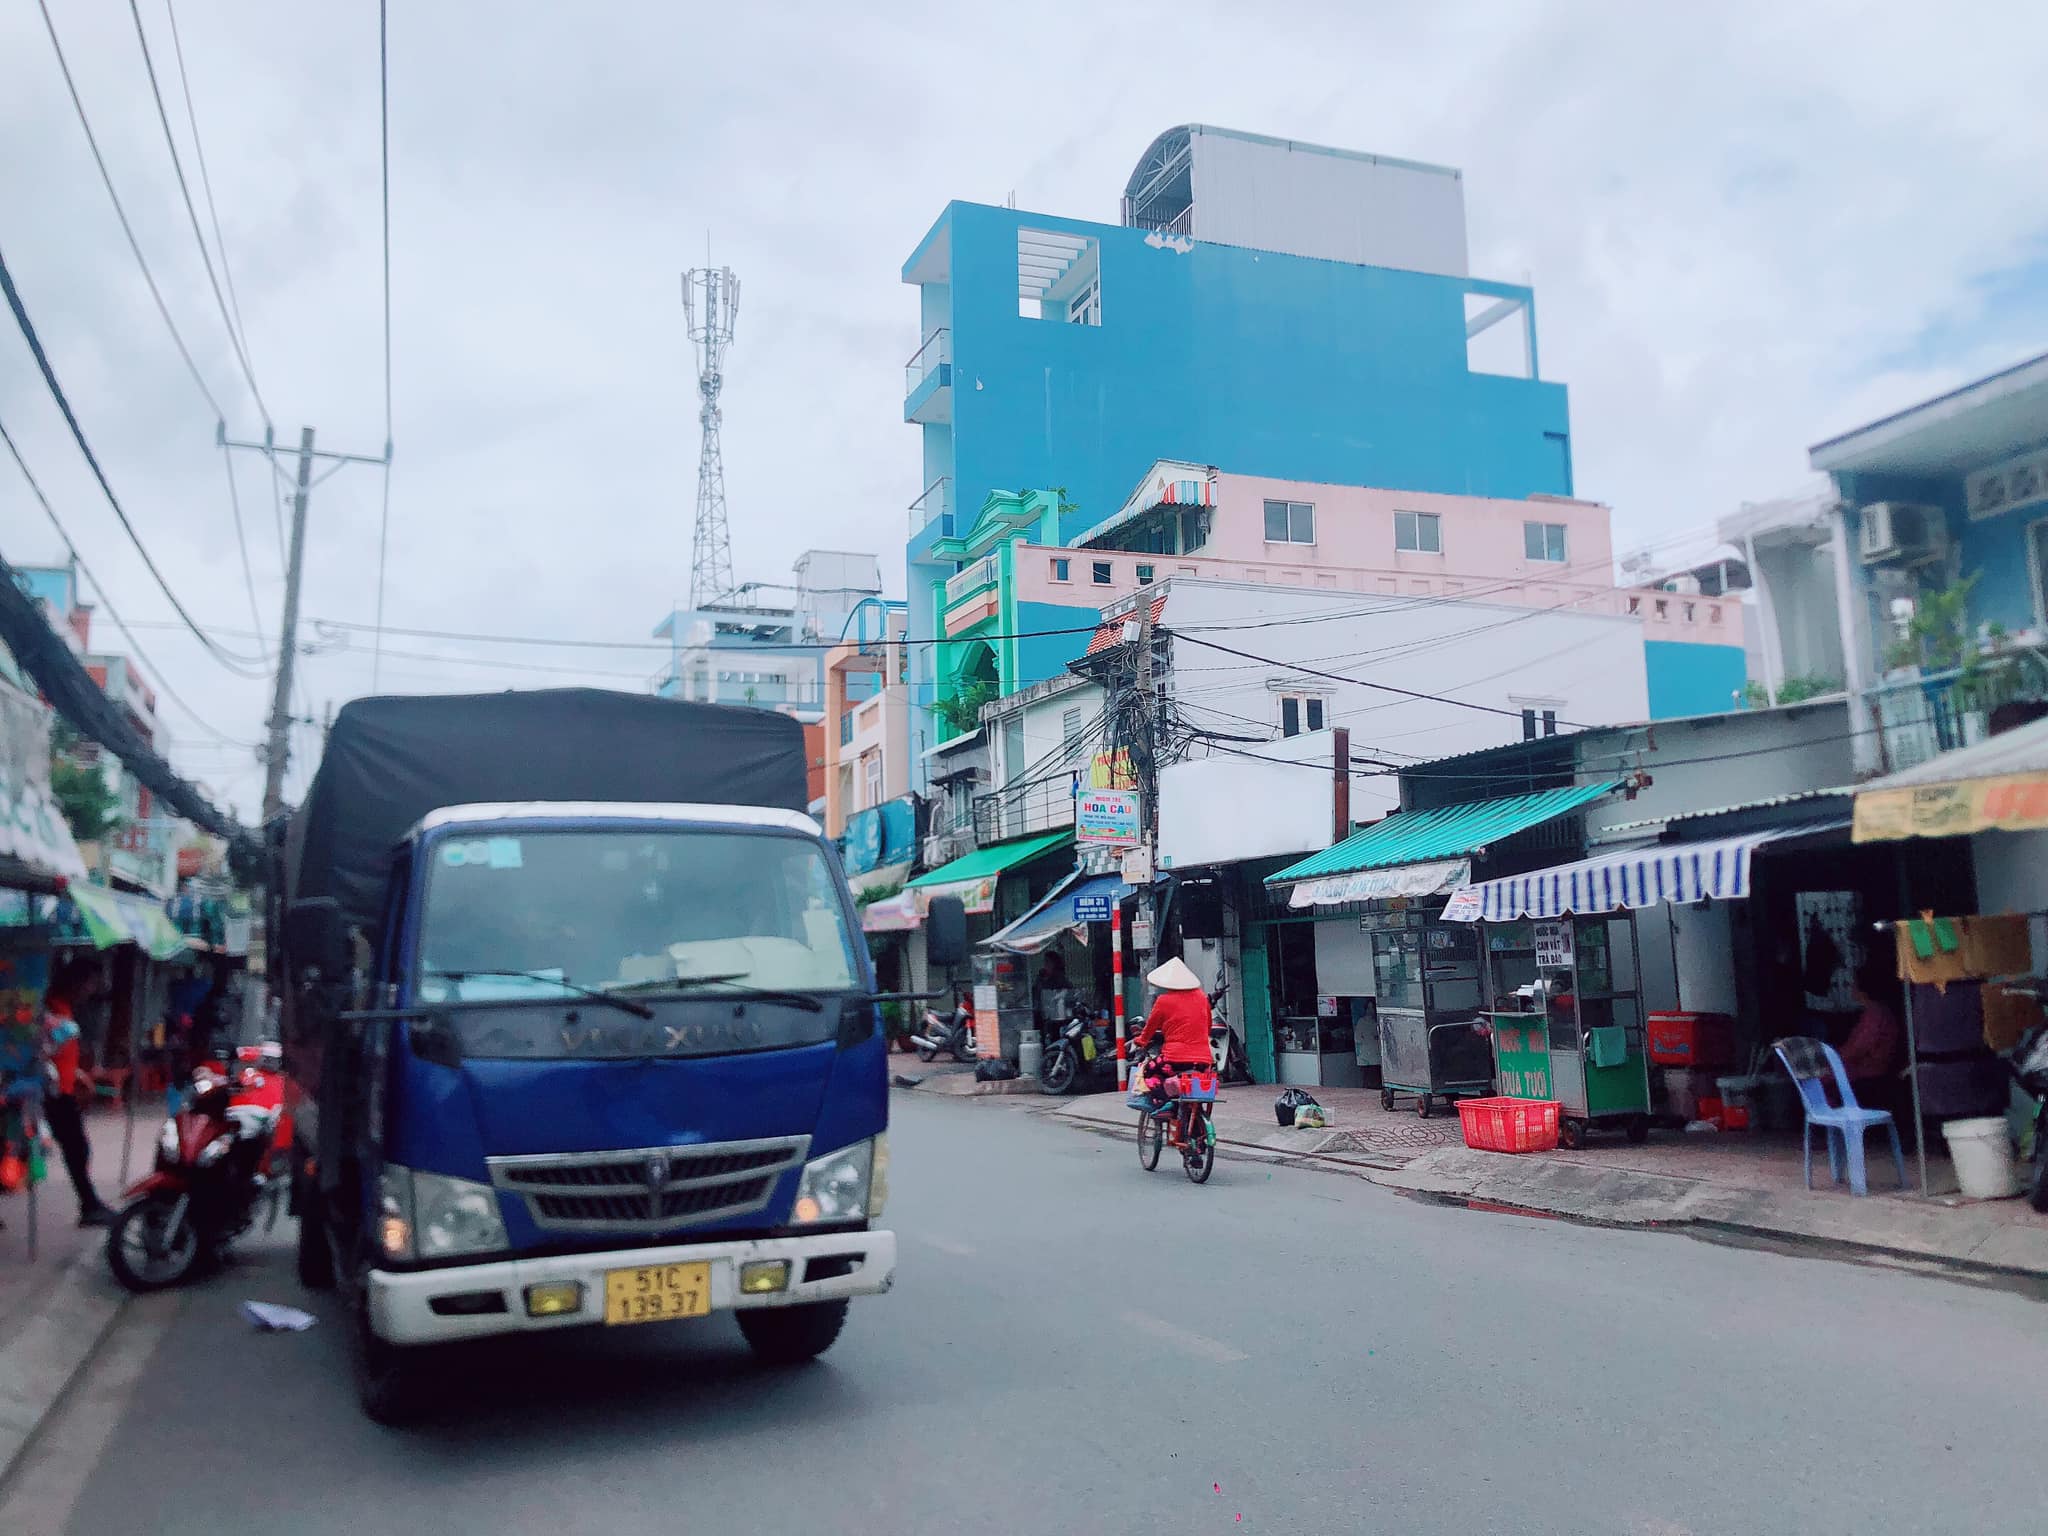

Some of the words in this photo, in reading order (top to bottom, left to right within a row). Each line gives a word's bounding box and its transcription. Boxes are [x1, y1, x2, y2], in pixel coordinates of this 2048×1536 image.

[1084, 802, 1106, 813] HOA
[1110, 804, 1131, 814] CAU
[637, 1267, 680, 1292] 51C
